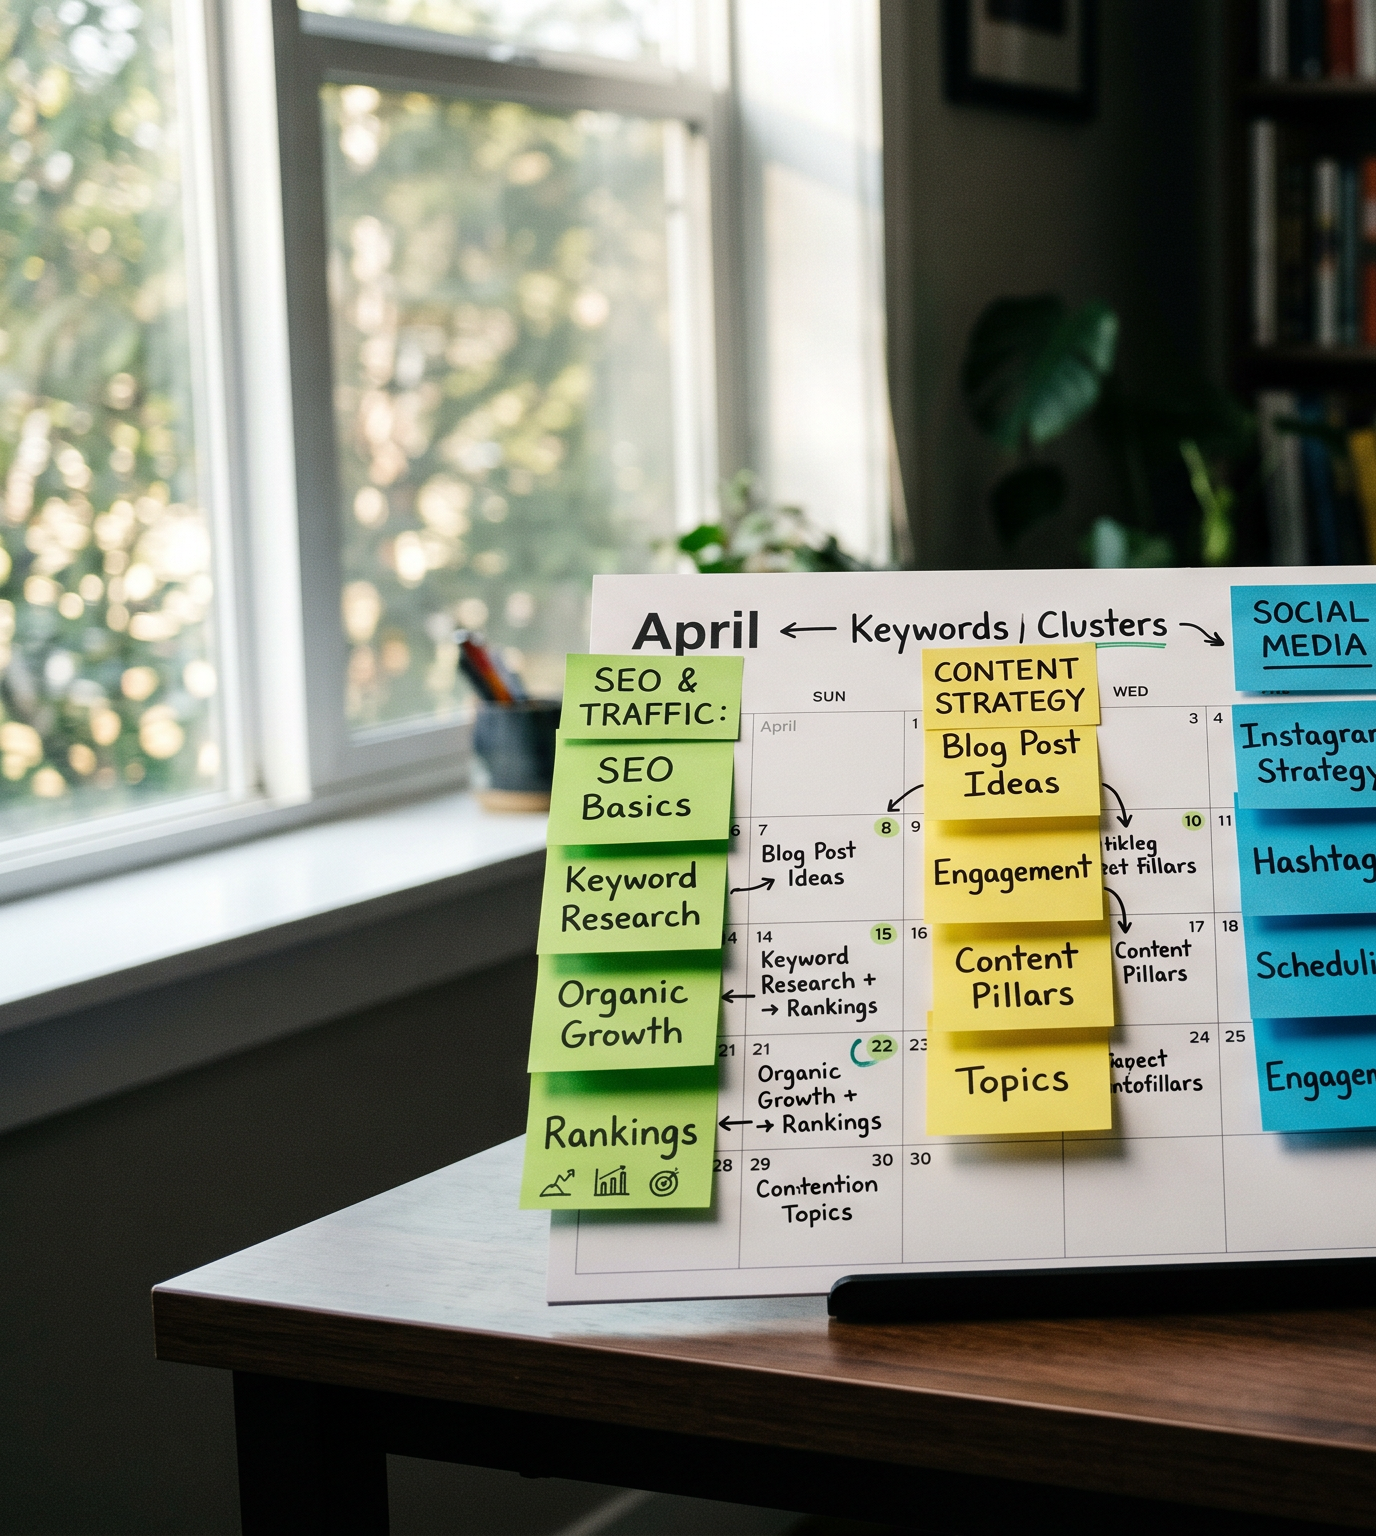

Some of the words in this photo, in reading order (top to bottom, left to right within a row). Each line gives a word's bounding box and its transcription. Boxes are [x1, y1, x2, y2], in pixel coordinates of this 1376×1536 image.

[1253, 599, 1370, 625] SOCIAL
[631, 610, 759, 657] April
[851, 610, 1009, 655] Keywords
[1037, 608, 1168, 639] Clusters
[1262, 632, 1368, 658] MEDIA
[594, 666, 662, 693] SEO
[677, 666, 698, 694] &
[934, 657, 1080, 683] CONTENT
[812, 690, 846, 703] SUN
[935, 687, 1086, 715] STRATEGY
[1112, 685, 1149, 698] WED
[579, 701, 727, 727] TRAFFIC:
[912, 717, 918, 729] 1
[1189, 712, 1199, 724] 3
[1213, 712, 1223, 724] 4
[760, 719, 797, 734] April
[942, 732, 1007, 769] Blog
[1020, 728, 1081, 756] Post
[596, 755, 674, 785] SEO
[963, 769, 1060, 798] Ideas
[582, 793, 692, 821] Basics
[758, 824, 768, 836] 7
[881, 821, 892, 835] 8
[910, 820, 921, 833] 9
[1184, 814, 1202, 827] 10
[1218, 814, 1232, 827] 11
[762, 843, 805, 869] Blog
[814, 840, 857, 861] Post
[566, 860, 697, 902] Keyword
[788, 868, 845, 887] Ideas
[934, 853, 1093, 896] Engagement
[561, 900, 700, 933] Research
[1188, 920, 1205, 933] 17
[1222, 919, 1239, 933] 18
[756, 930, 773, 944] 14
[875, 927, 892, 941] 15
[911, 926, 928, 940] 16
[761, 944, 850, 975] Keyword
[955, 941, 1079, 974] Content
[1114, 938, 1192, 960] Content
[761, 971, 856, 995] Research
[1122, 964, 1188, 985] Pillars
[558, 979, 689, 1019] Organic
[972, 981, 1074, 1010] Pillars
[787, 997, 878, 1023] Rankings
[561, 1016, 683, 1049] Growth
[1189, 1030, 1210, 1044] 24
[1225, 1029, 1246, 1043] 25
[719, 1043, 735, 1057] 21
[752, 1042, 770, 1056] 21
[871, 1039, 893, 1053] 22
[757, 1061, 842, 1091] Organic
[954, 1065, 1069, 1103] Topics
[757, 1086, 836, 1110] Growth
[544, 1114, 698, 1161] Rankings
[782, 1112, 882, 1139] Rankings
[713, 1158, 733, 1172] 28
[750, 1157, 771, 1172] 29
[872, 1153, 894, 1167] 30
[910, 1152, 932, 1166] 30
[781, 1202, 853, 1229] Topics
